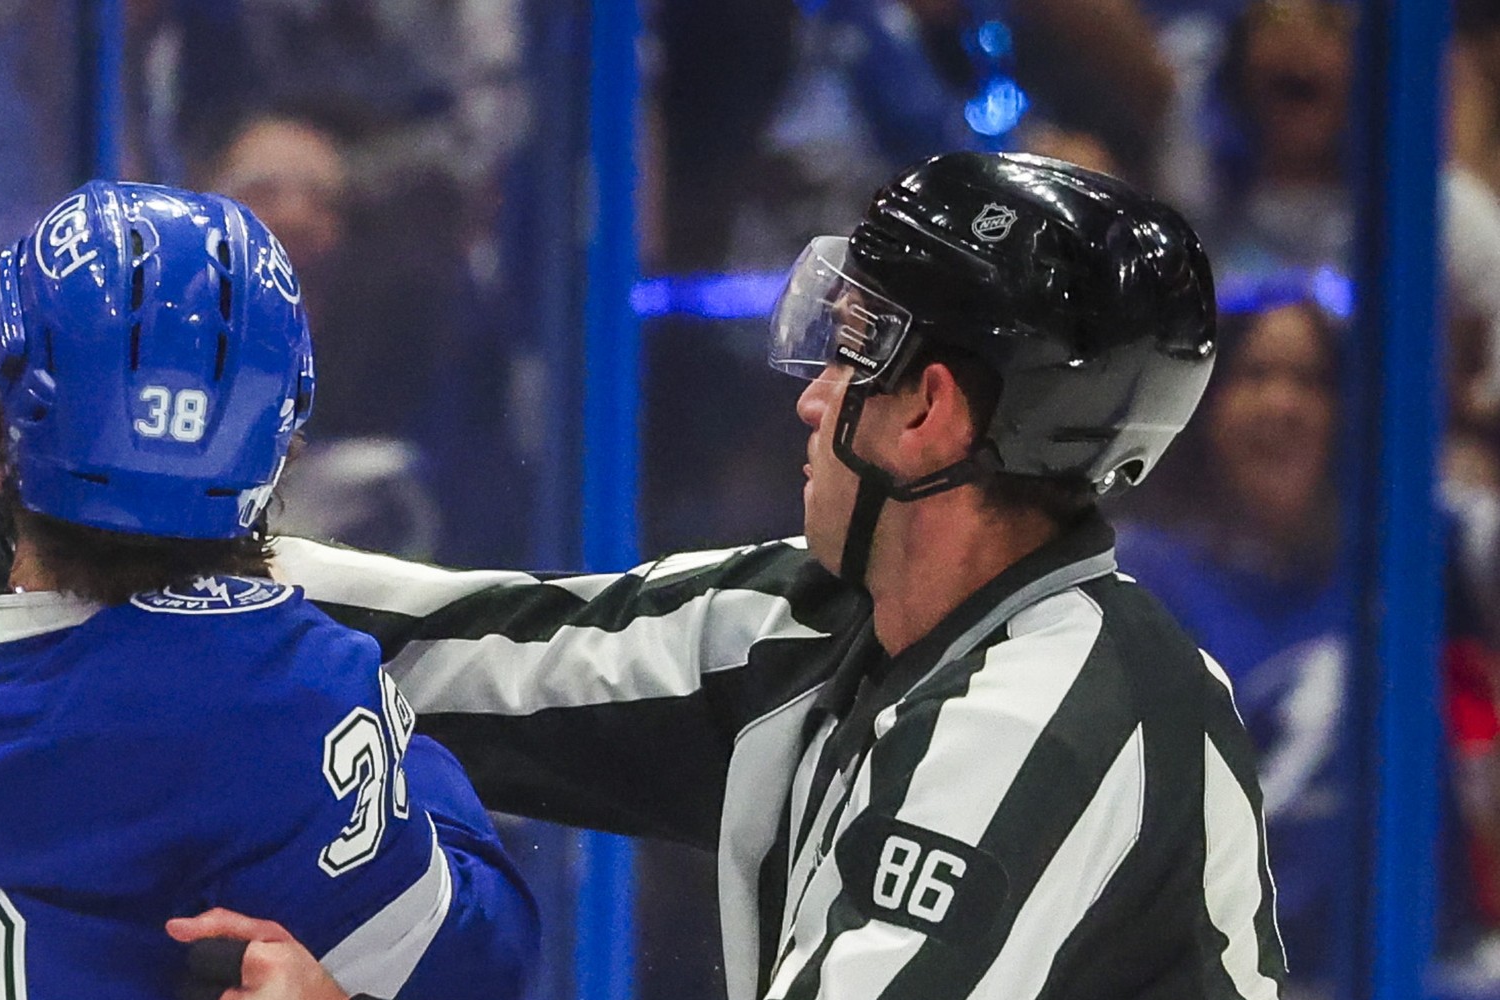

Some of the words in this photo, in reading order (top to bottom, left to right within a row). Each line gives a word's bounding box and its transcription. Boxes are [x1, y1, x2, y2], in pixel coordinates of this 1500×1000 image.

[977, 217, 1007, 230] NHL
[133, 384, 208, 443] 38
[873, 835, 967, 923] 86
